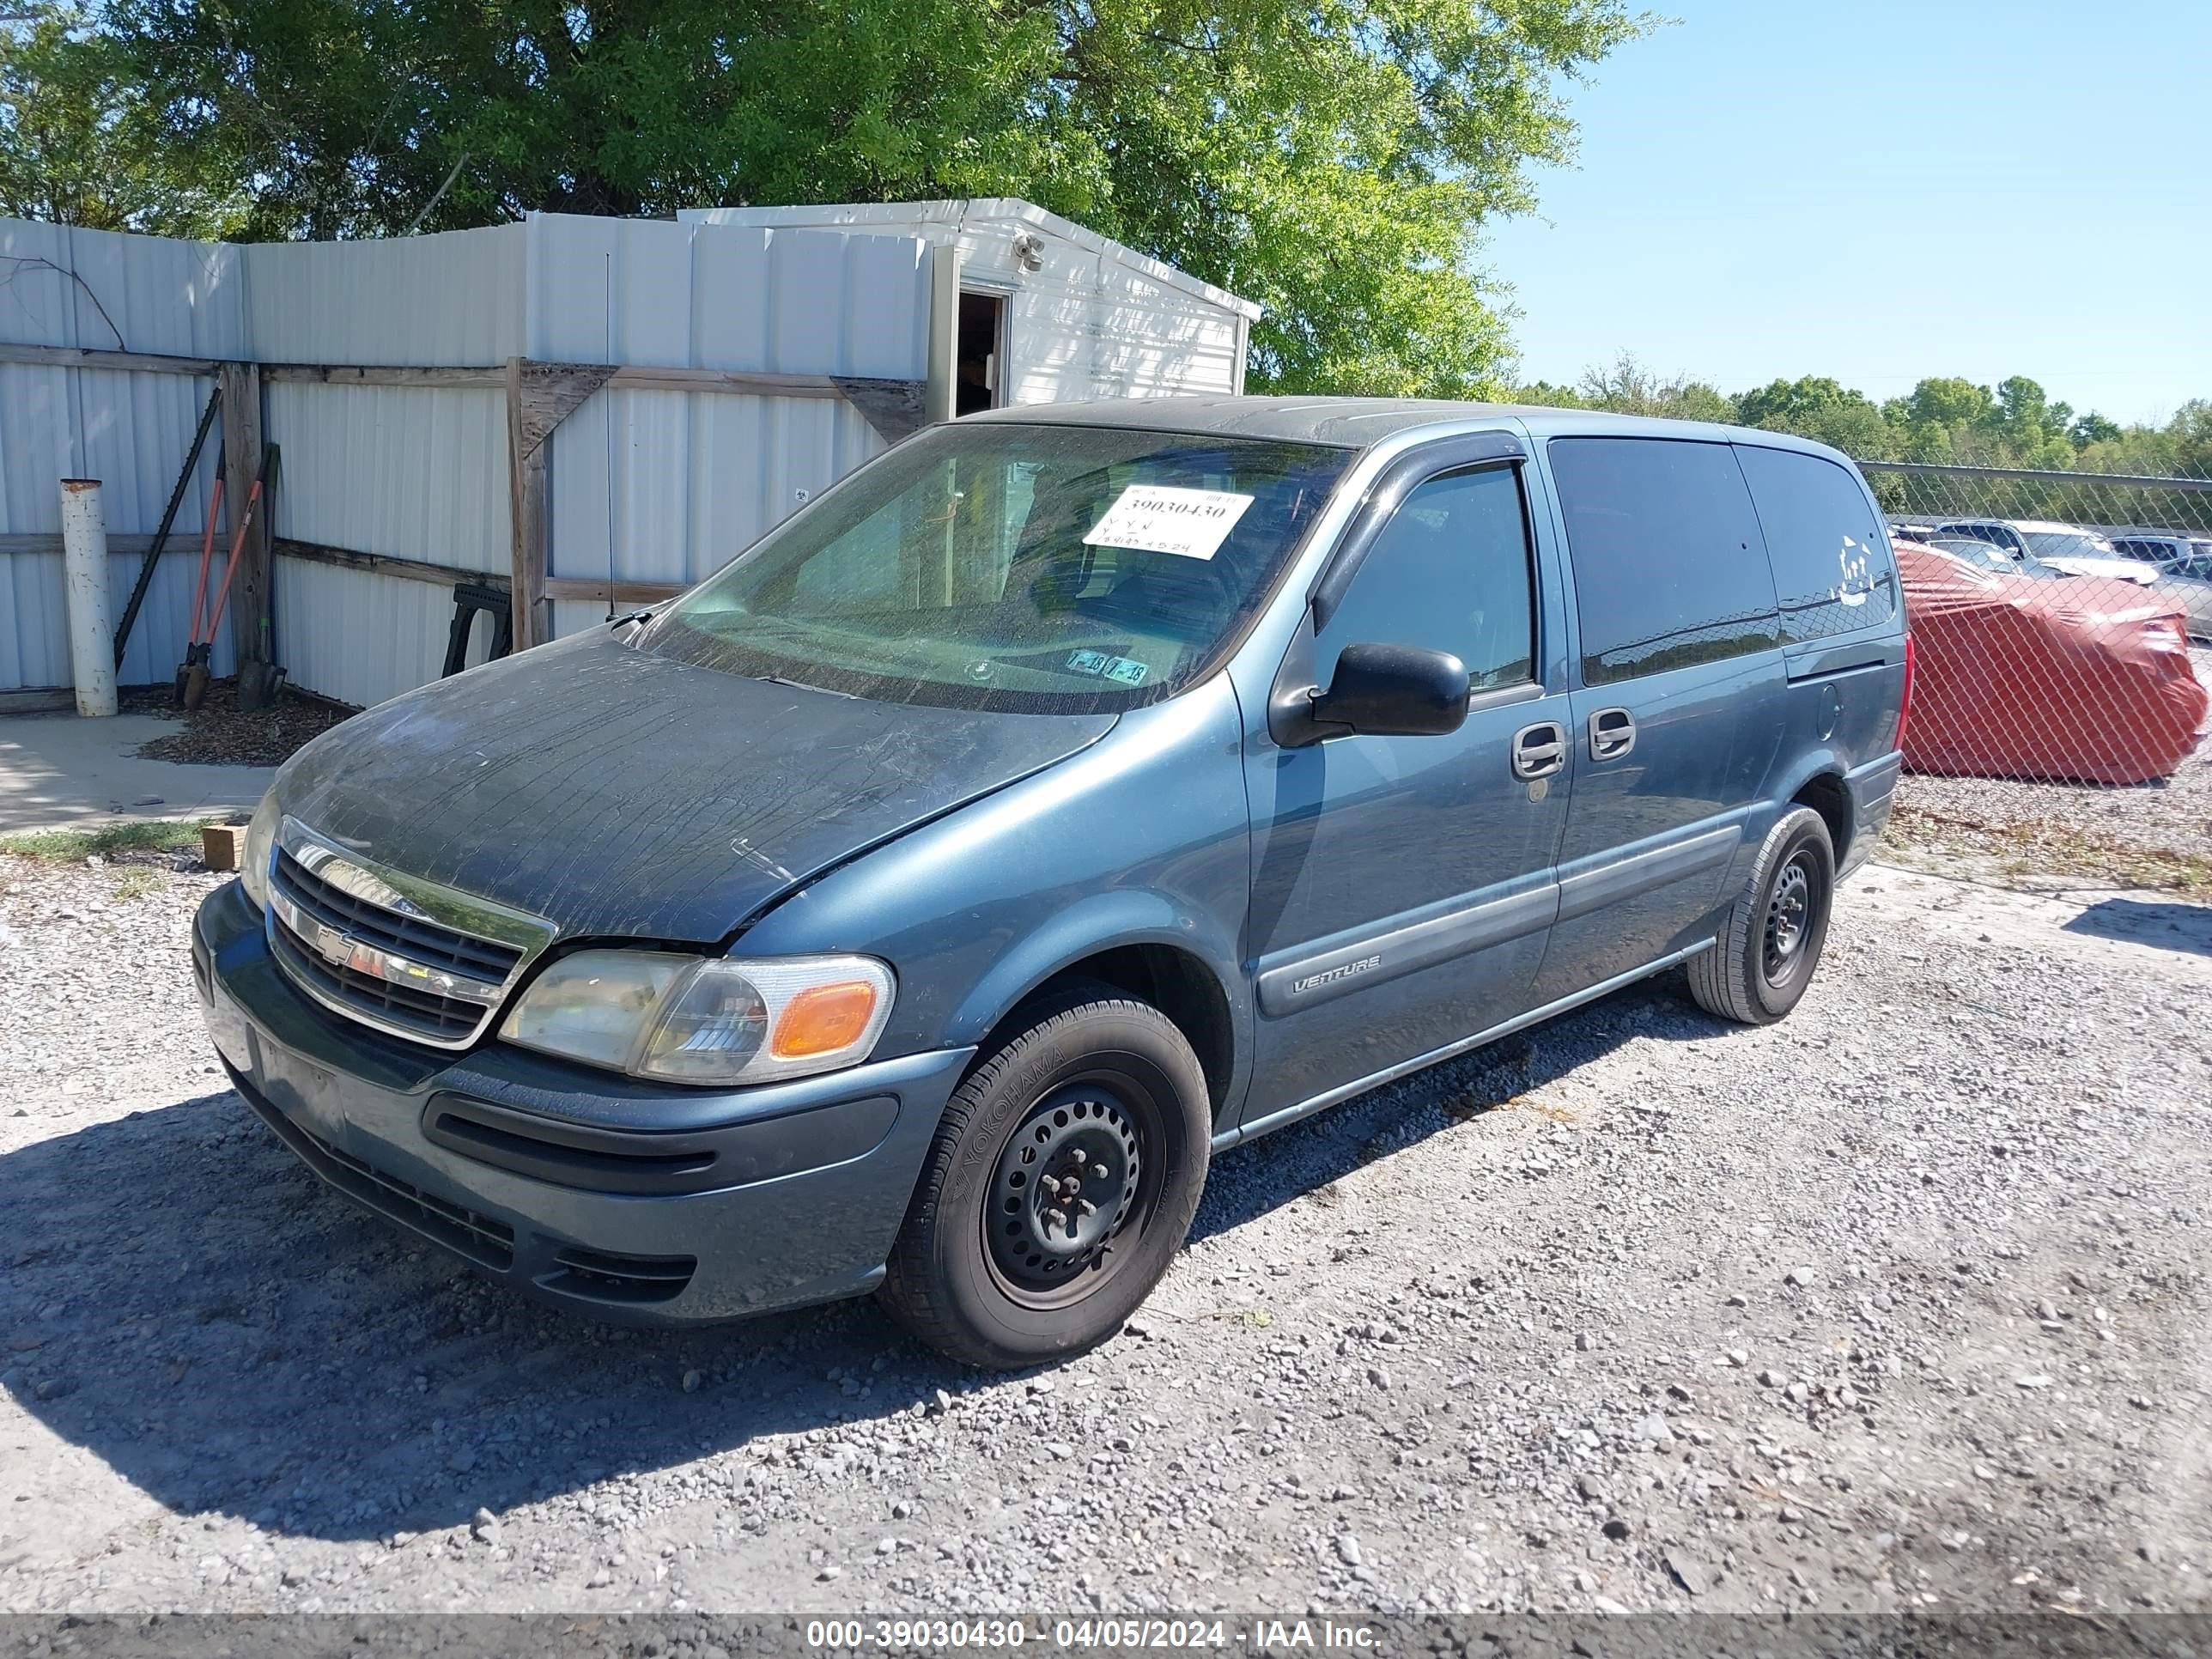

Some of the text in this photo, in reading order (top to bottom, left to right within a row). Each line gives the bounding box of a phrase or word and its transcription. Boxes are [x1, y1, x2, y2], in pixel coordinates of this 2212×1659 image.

[1125, 499, 1226, 519] 39030430
[1127, 665, 1145, 681] 18
[1292, 954, 1382, 994] VENTURE
[964, 1044, 1066, 1166] YOKOHAMA
